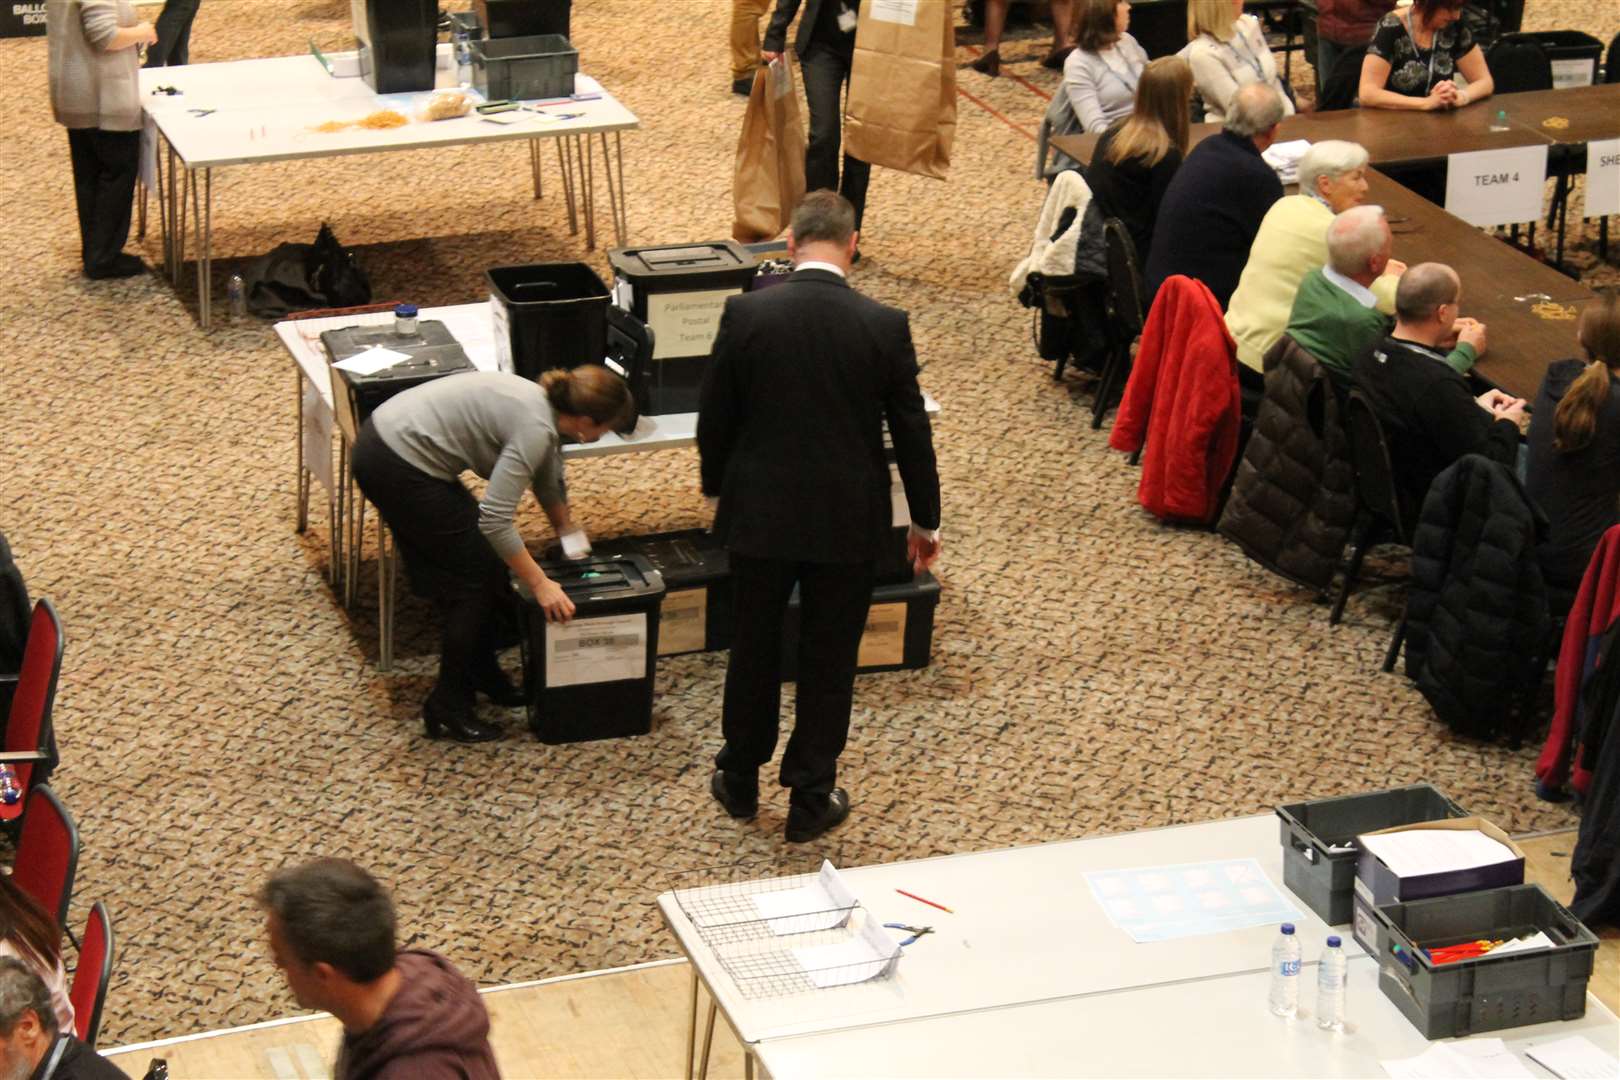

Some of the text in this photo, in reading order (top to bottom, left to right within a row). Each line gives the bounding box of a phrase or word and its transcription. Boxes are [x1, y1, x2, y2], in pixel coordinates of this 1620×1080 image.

[1474, 172, 1520, 186] TEAM 4
[682, 317, 711, 325] Postal
[680, 333, 705, 341] Team
[578, 637, 600, 648] BOX
